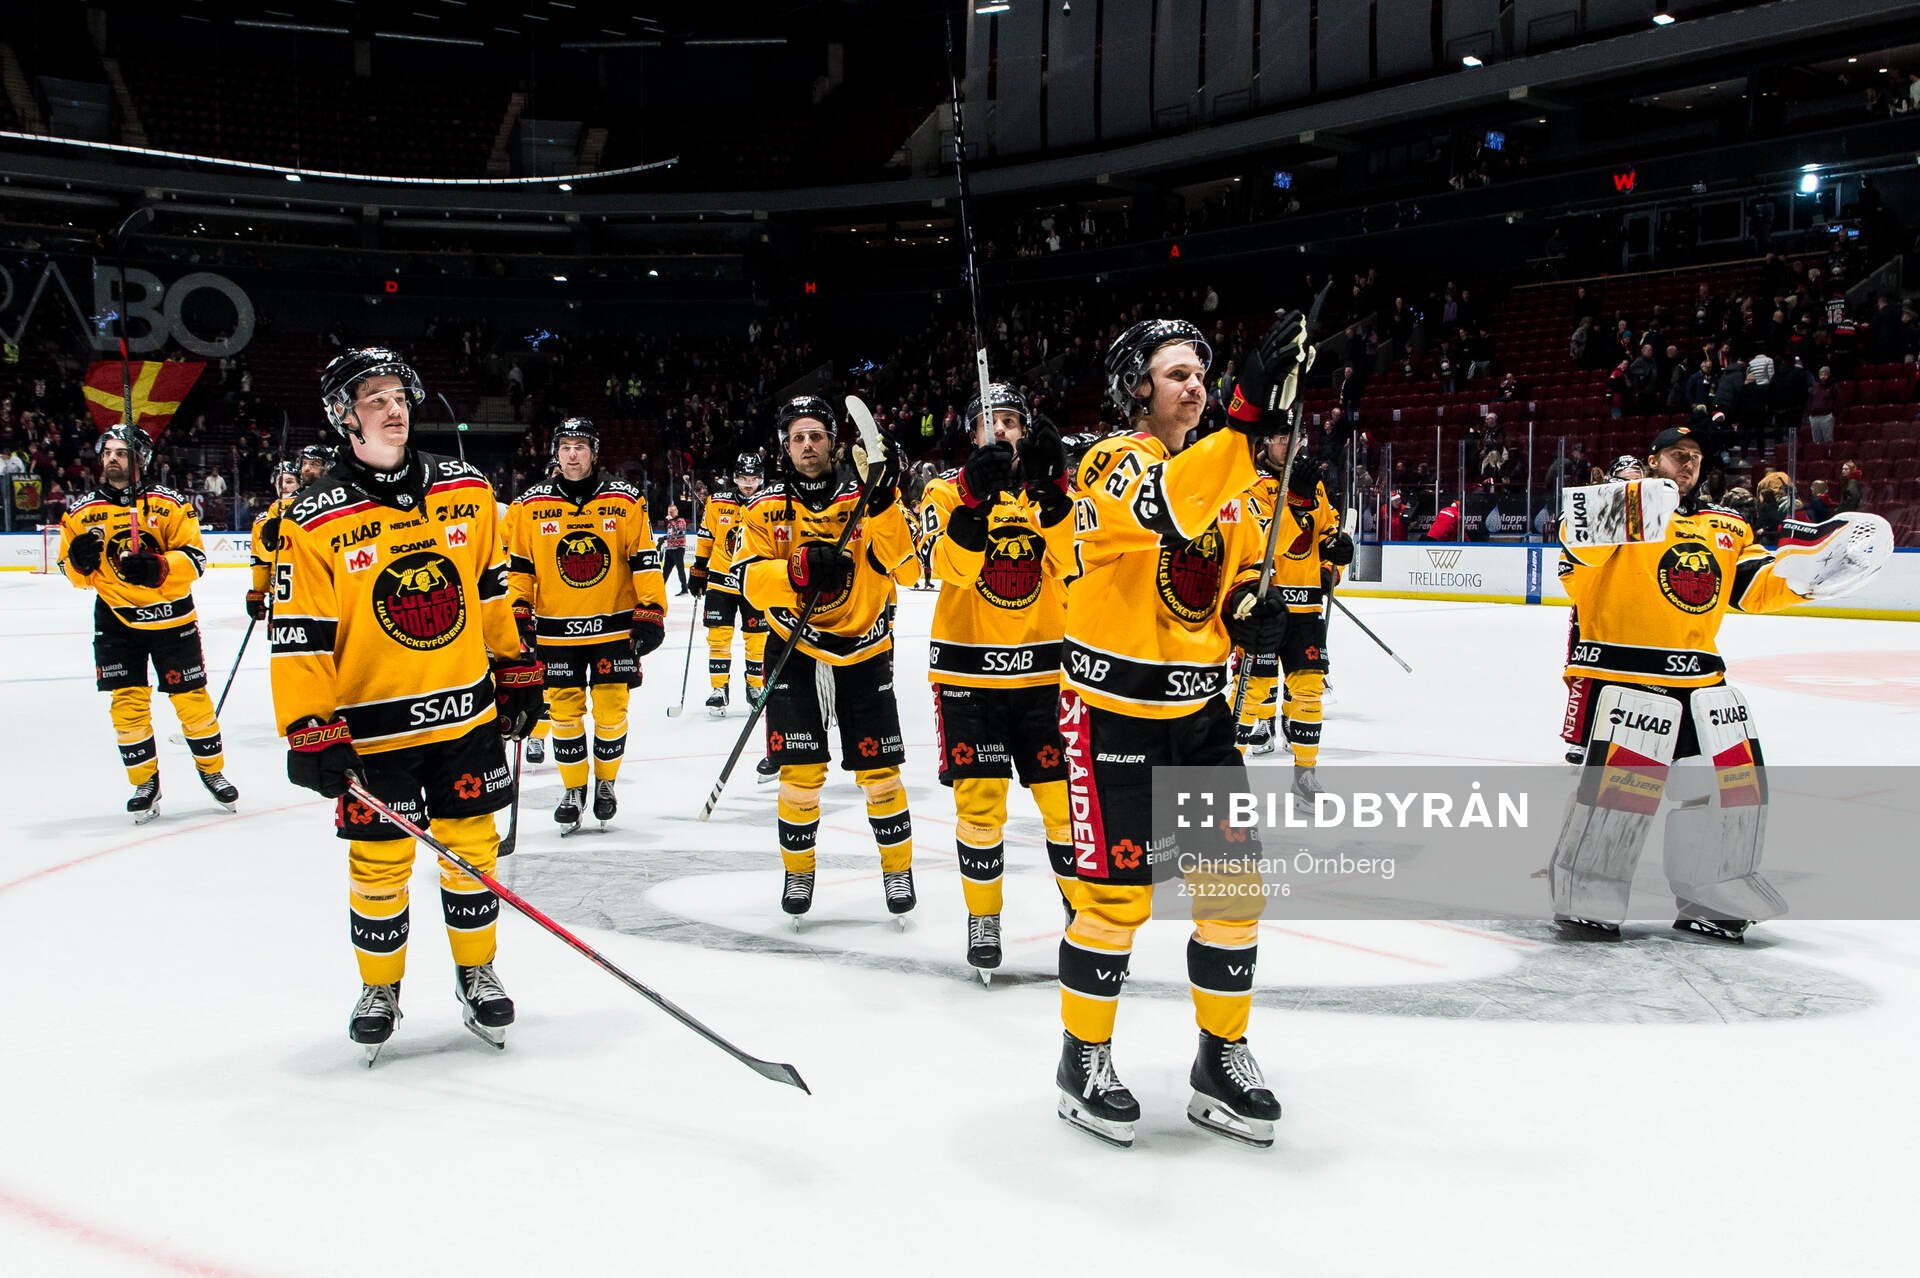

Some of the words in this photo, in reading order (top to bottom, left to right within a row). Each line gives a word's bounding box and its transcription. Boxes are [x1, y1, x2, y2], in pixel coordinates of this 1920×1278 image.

[1613, 171, 1637, 191] W
[385, 280, 399, 292] D
[805, 282, 816, 294] H
[1104, 449, 1145, 500] 27
[524, 485, 552, 497] SSAB
[609, 481, 640, 497] SSAB
[293, 487, 348, 521] SSAB
[1573, 491, 1588, 529] LKAB
[539, 508, 563, 519] LKAB
[342, 521, 382, 547] LKAB
[390, 538, 438, 554] SCANIA
[1159, 551, 1172, 587] LULEÅ
[1408, 571, 1482, 588] TRELLEBORG
[136, 605, 173, 620] SSAB
[376, 600, 396, 631] LULEÅ
[565, 619, 603, 635] SSAB
[982, 651, 1034, 672] SSAB
[1571, 645, 1602, 662] SAB
[547, 662, 569, 670] Luleå
[1071, 650, 1111, 682] SAB
[1256, 658, 1278, 666] Energ
[410, 692, 473, 726] SSAB
[1719, 705, 1748, 725] LKAB
[1624, 712, 1673, 736] LKAB
[785, 732, 812, 741] Luleå
[786, 741, 819, 750] Energi
[882, 744, 904, 754] Energ
[976, 742, 1005, 752] Luleå
[1096, 753, 1146, 764] BAUER
[484, 767, 508, 782] Luleå
[1723, 770, 1751, 783] BAUER
[1609, 774, 1661, 792] BAUER
[386, 799, 417, 812] uleå
[1147, 845, 1180, 865] Energ
